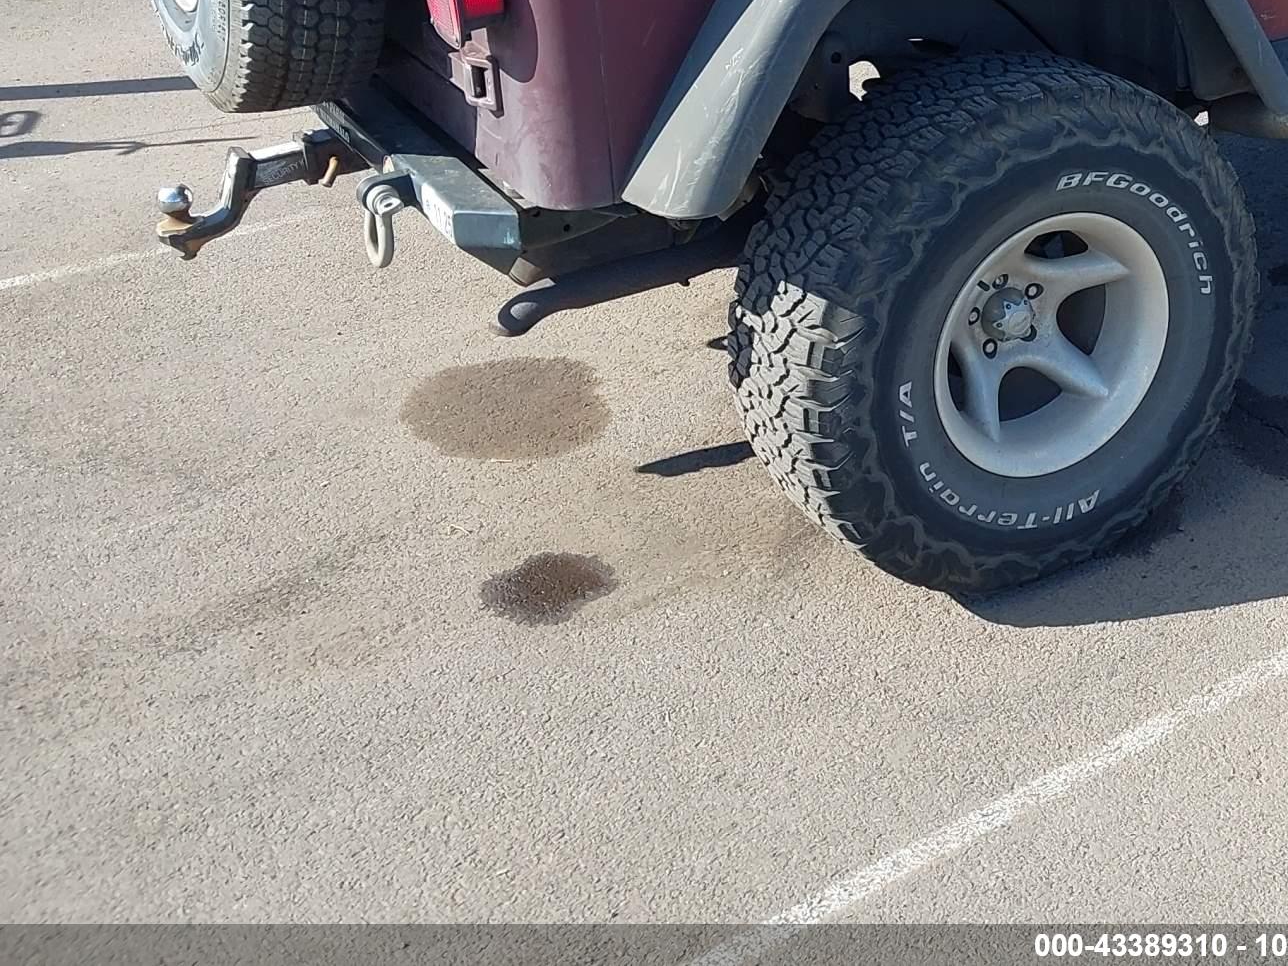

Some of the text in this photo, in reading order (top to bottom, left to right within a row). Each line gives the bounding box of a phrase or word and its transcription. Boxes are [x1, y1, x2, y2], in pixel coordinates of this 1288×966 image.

[1056, 170, 1213, 295] BFGoodrich
[898, 380, 1102, 530] All-Terrain T/A
